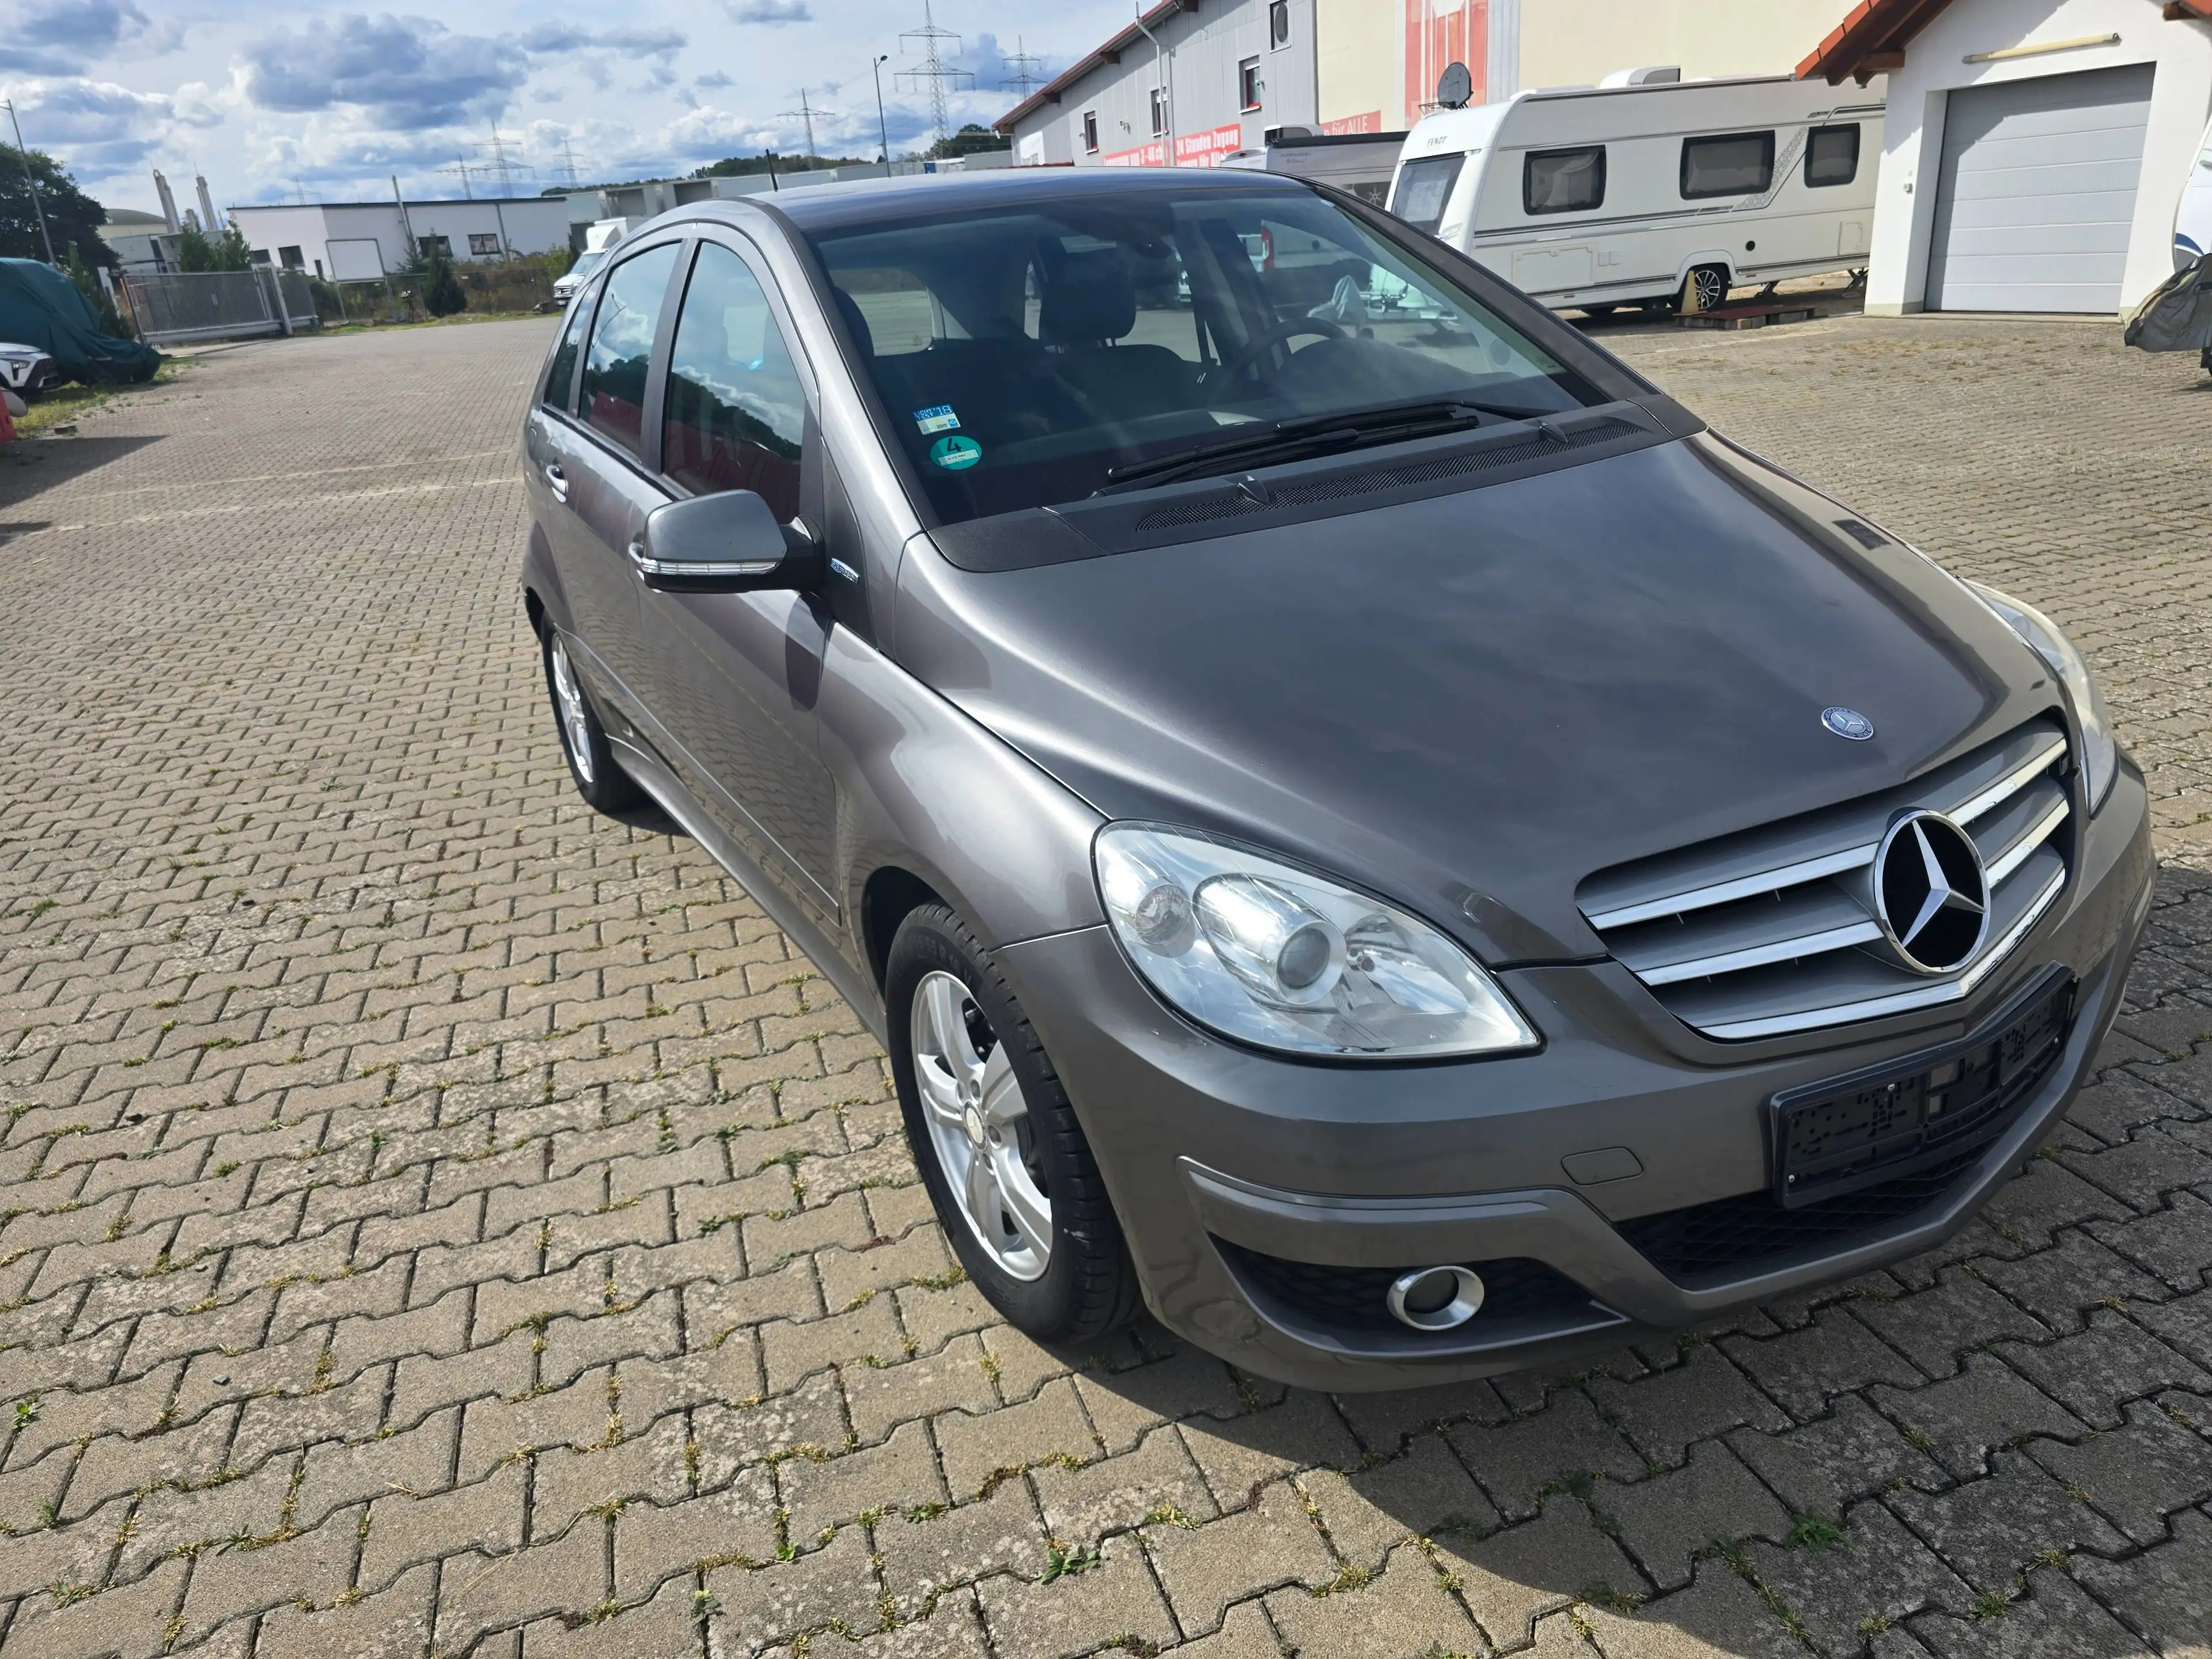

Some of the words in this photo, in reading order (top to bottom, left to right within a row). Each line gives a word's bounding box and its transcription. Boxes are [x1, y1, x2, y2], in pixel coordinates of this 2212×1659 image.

[1185, 134, 1211, 154] Stunden
[1213, 129, 1238, 149] Zugang
[946, 437, 962, 452] 4
